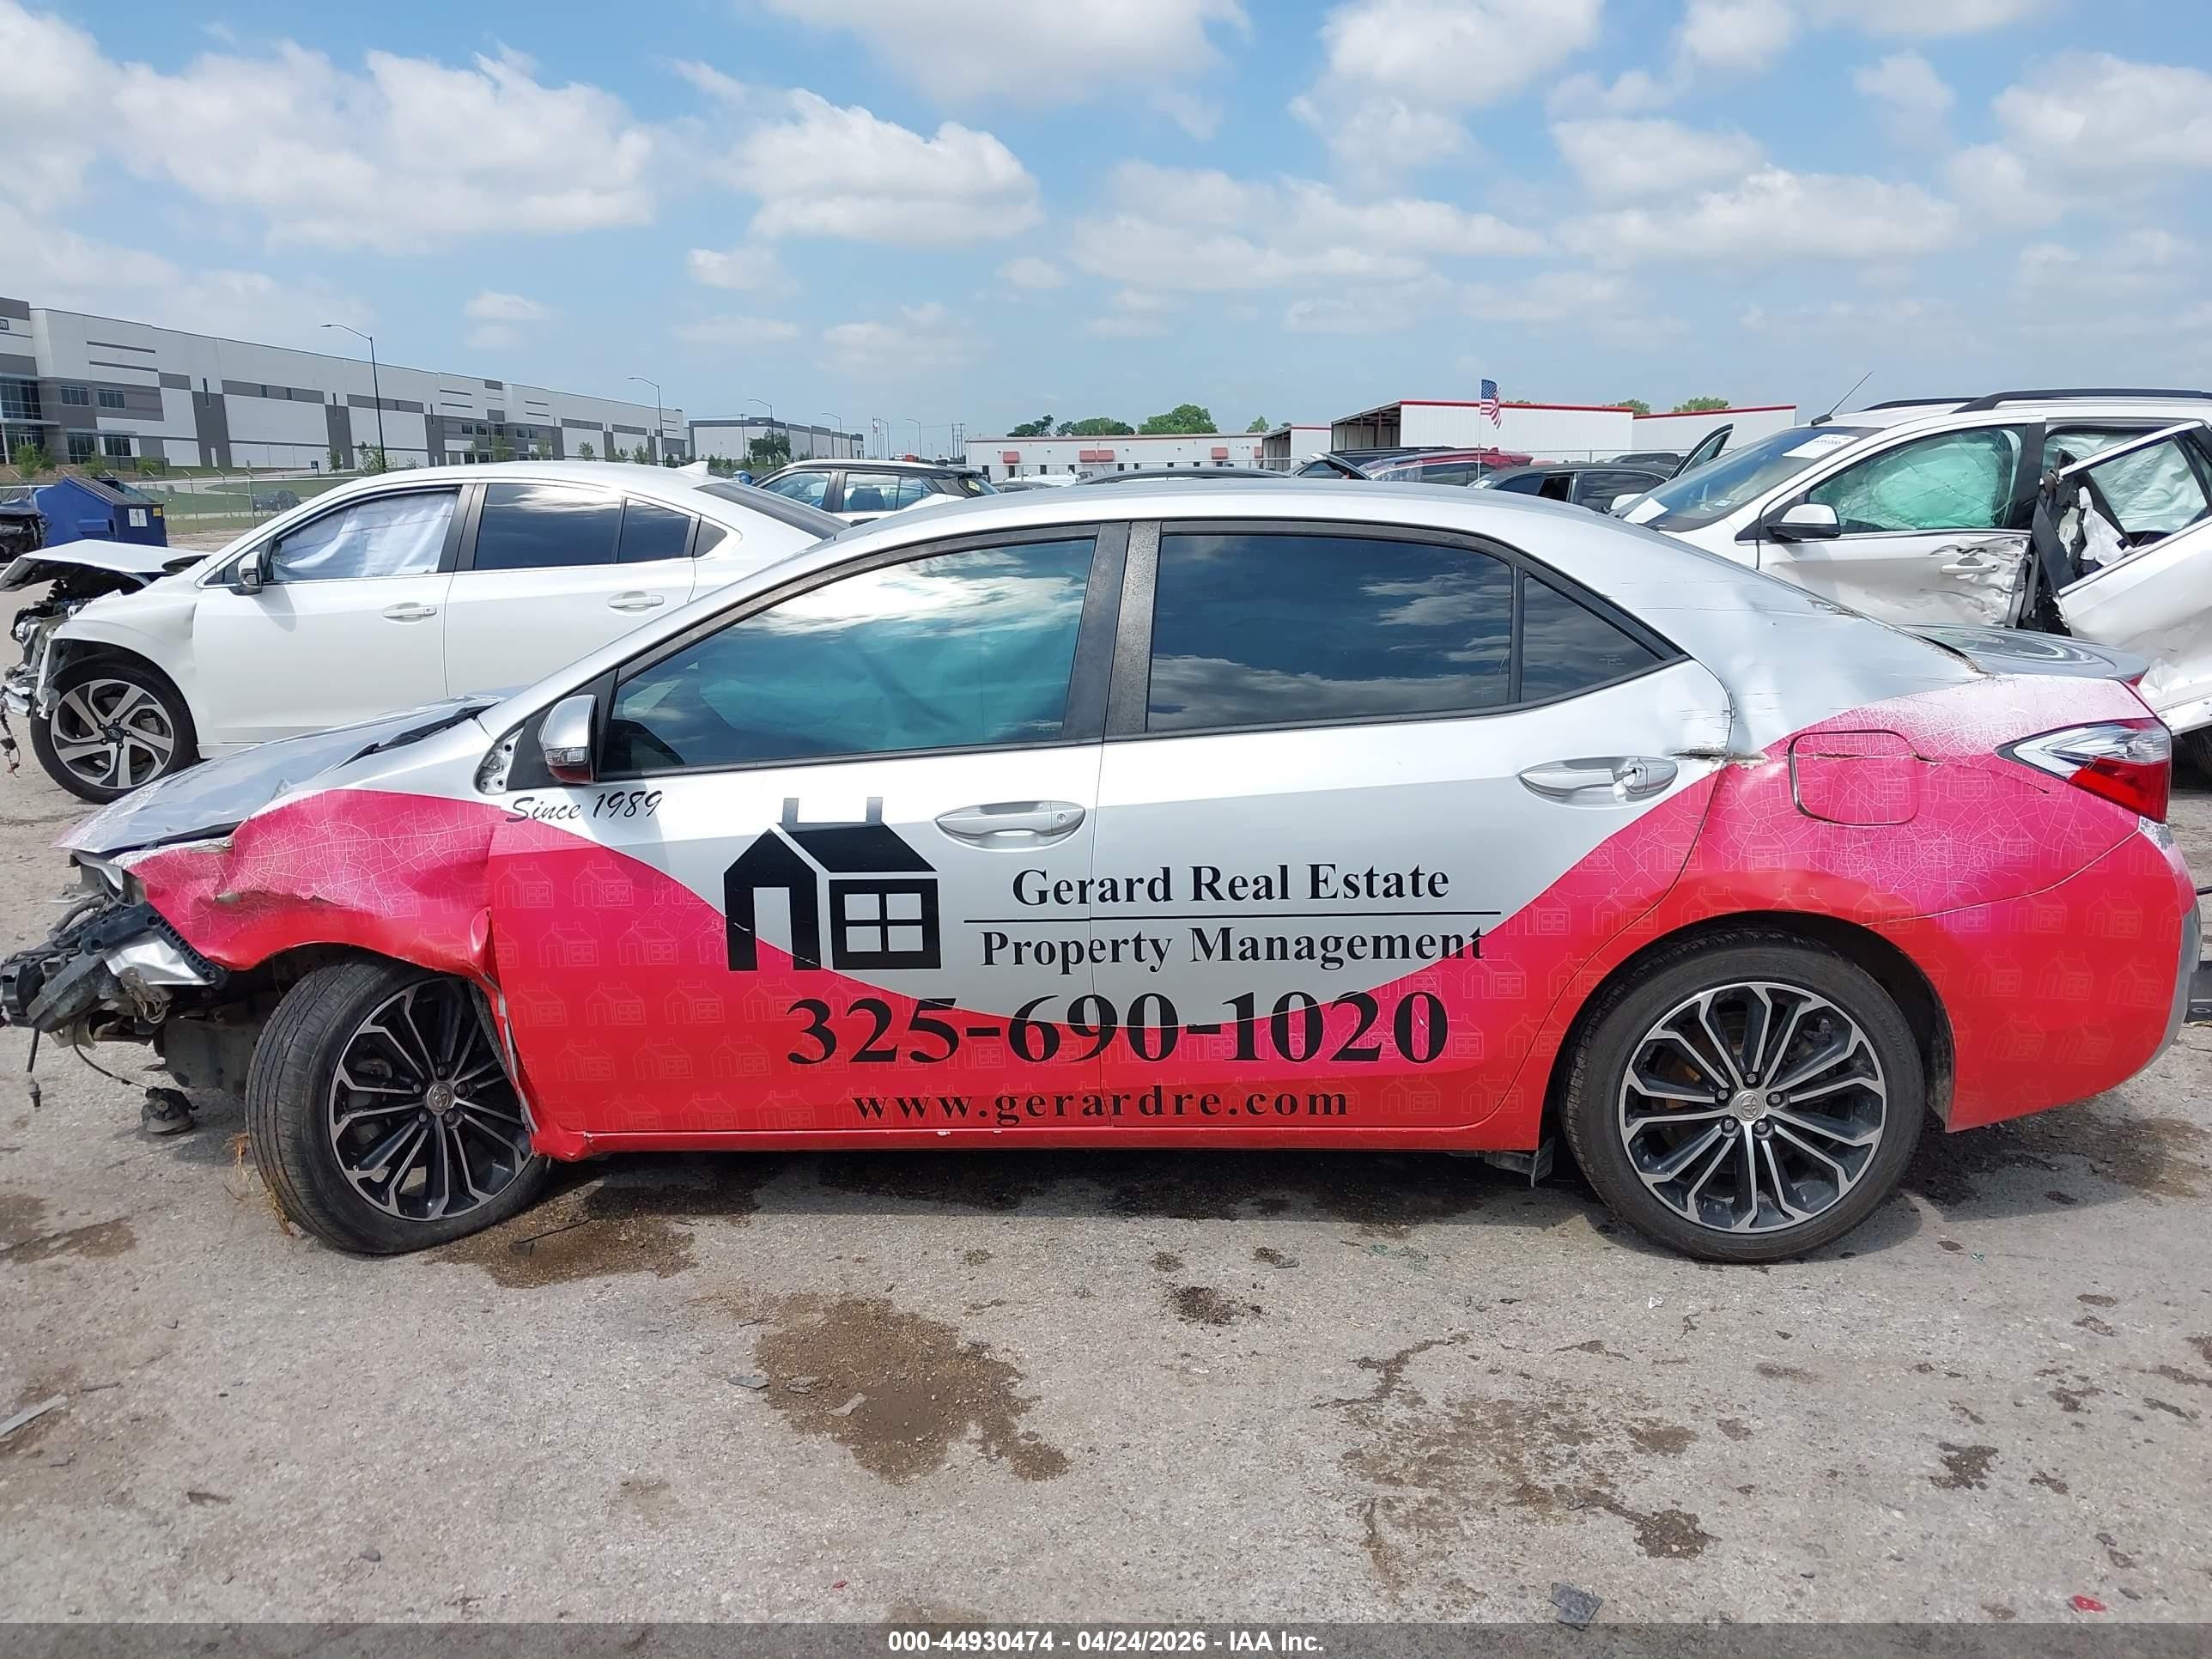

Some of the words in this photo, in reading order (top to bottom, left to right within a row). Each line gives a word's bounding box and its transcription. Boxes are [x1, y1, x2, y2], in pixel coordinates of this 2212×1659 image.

[506, 796, 582, 823] Since
[592, 789, 664, 818] 1989
[1012, 866, 1174, 906] Gerard
[1189, 864, 1290, 902] Real
[1308, 863, 1449, 900] Estate
[981, 931, 1174, 975] Property
[1188, 926, 1486, 972] Management
[787, 991, 1449, 1065] 325-690-1020
[854, 1085, 1348, 1128] www.gerardre.com
